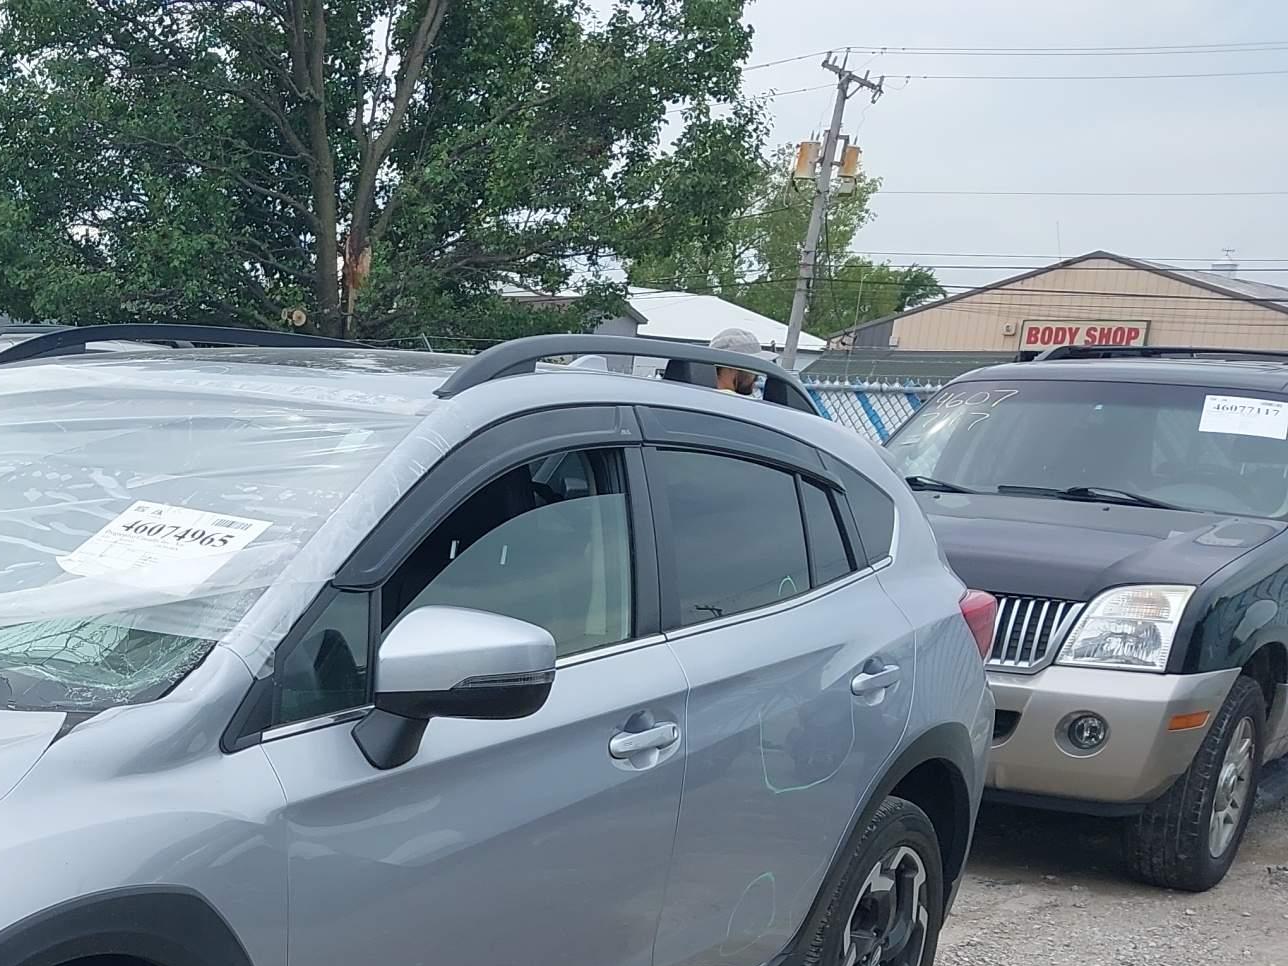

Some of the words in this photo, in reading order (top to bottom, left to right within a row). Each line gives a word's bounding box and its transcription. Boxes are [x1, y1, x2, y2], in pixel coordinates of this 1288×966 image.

[1026, 327, 1080, 345] BODY
[1084, 327, 1140, 346] SHOP
[936, 389, 1020, 410] 4607
[122, 519, 235, 548] 46074965
